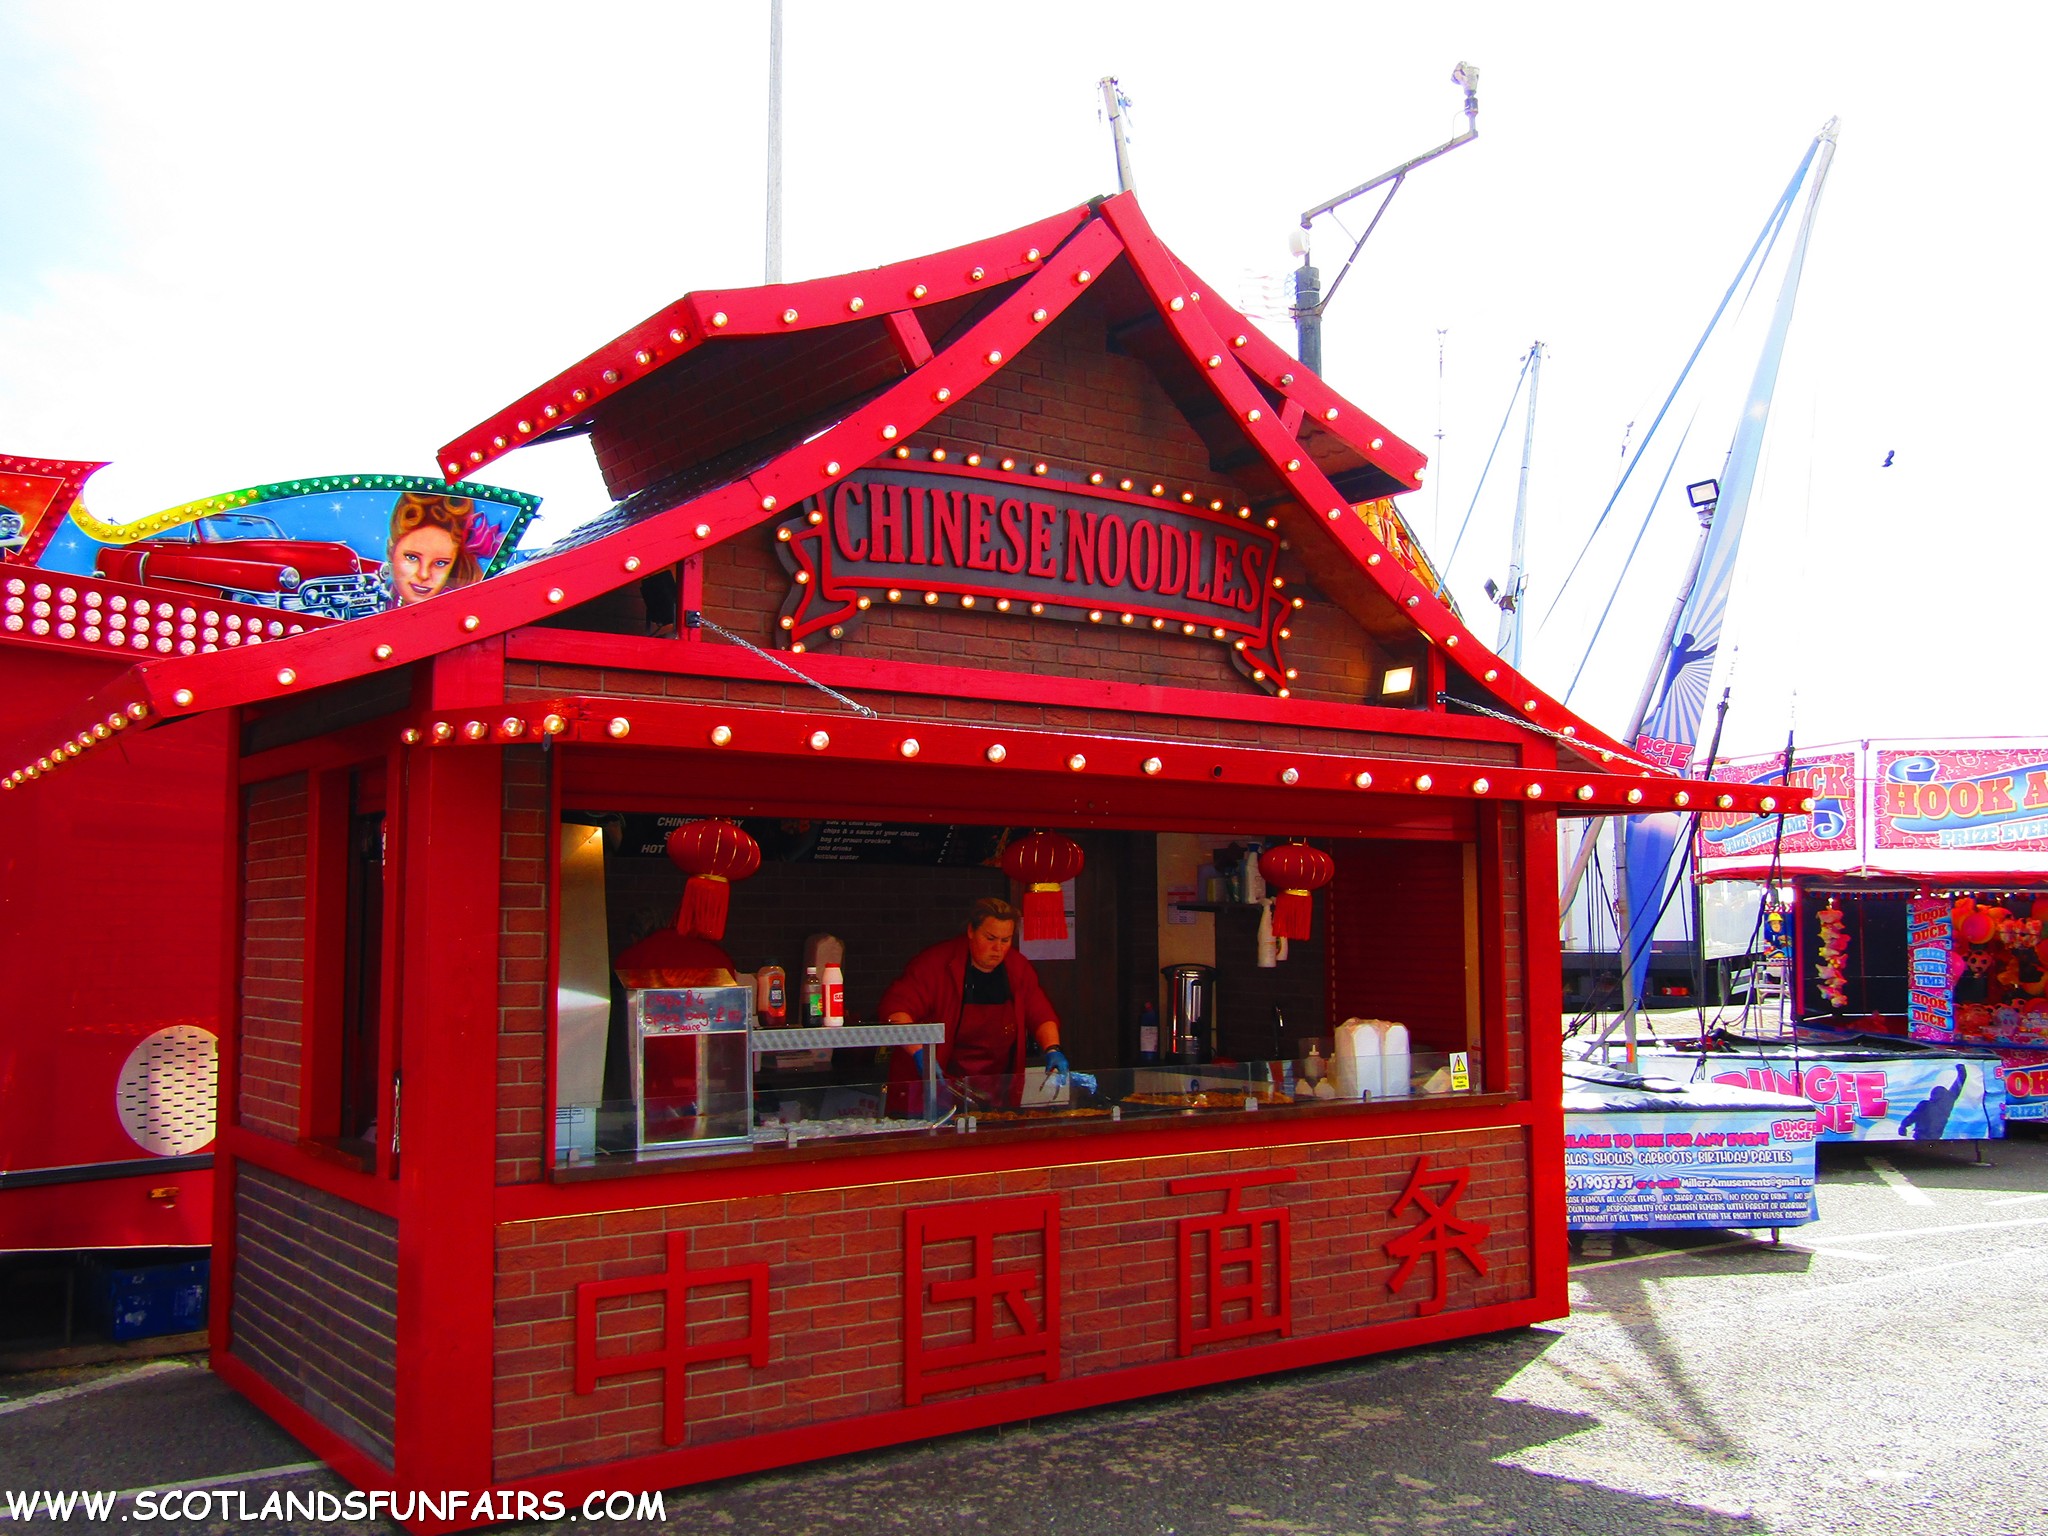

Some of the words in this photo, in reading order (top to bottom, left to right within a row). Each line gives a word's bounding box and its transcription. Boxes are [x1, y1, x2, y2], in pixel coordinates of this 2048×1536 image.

[834, 482, 1057, 578] CHINESE
[1065, 509, 1263, 613] NOODLES
[1886, 777, 2016, 819] HOOK
[2023, 771, 2048, 809] A
[823, 827, 841, 835] chips
[900, 830, 920, 838] choice
[1723, 836, 1749, 853] PRIZE
[1749, 825, 1777, 845] EVERY
[1940, 826, 1998, 846] PRIZE
[641, 844, 665, 854] HOT
[1914, 907, 1948, 923] HOOK
[1912, 924, 1948, 944] DUCK
[1915, 949, 1946, 959] PRIZE
[1914, 962, 1946, 973] EVERY
[1912, 992, 1947, 1010] HOOK
[1913, 1011, 1946, 1028] DUCK
[674, 1024, 702, 1032] sauce
[1613, 1134, 1633, 1148] TO
[1633, 1133, 1665, 1148] HIRE
[1665, 1133, 1693, 1147] FOR
[1693, 1133, 1725, 1147] ANY
[1726, 1132, 1769, 1147] EVENT
[1785, 1132, 1811, 1141] ZONE
[1593, 1152, 1634, 1165] SHOWS
[1638, 1151, 1693, 1165] CARBOOTS
[1698, 1150, 1748, 1163] BIRTHDAY
[1749, 1150, 1793, 1163] PARTIES
[1636, 1180, 1647, 1189] or
[1648, 1178, 1681, 1188] e-mail
[1581, 1195, 1606, 1203] REMOVE
[1606, 1195, 1616, 1203] ALL
[1616, 1195, 1637, 1203] LOOSE
[1637, 1195, 1656, 1203] ITEMS
[1662, 1194, 1673, 1202] NO
[1674, 1194, 1694, 1202] SHARP
[1695, 1194, 1723, 1202] OBJECTS
[1729, 1193, 1739, 1201] NO
[1740, 1193, 1760, 1201] FOOD
[1770, 1192, 1788, 1200] DRINK
[1794, 1192, 1804, 1200] NO
[1585, 1205, 1600, 1213] RISK
[1606, 1204, 1655, 1213] RESPONSIBILITY
[1669, 1203, 1698, 1211] CHILDREN
[1699, 1203, 1726, 1211] REMAINS
[1726, 1202, 1744, 1210] WITH
[1745, 1202, 1769, 1210] PARENT
[1770, 1202, 1779, 1210] OR
[1573, 1214, 1609, 1222] ATTENDANT
[1610, 1214, 1618, 1222] AT
[1619, 1214, 1629, 1222] ALL
[1630, 1214, 1649, 1222] TIMES
[1655, 1213, 1696, 1221] MANAGEMENT
[1697, 1212, 1719, 1220] RETAIN
[1720, 1212, 1732, 1220] THE
[1733, 1211, 1751, 1220] RIGHT
[1763, 1211, 1784, 1219] REFUSE
